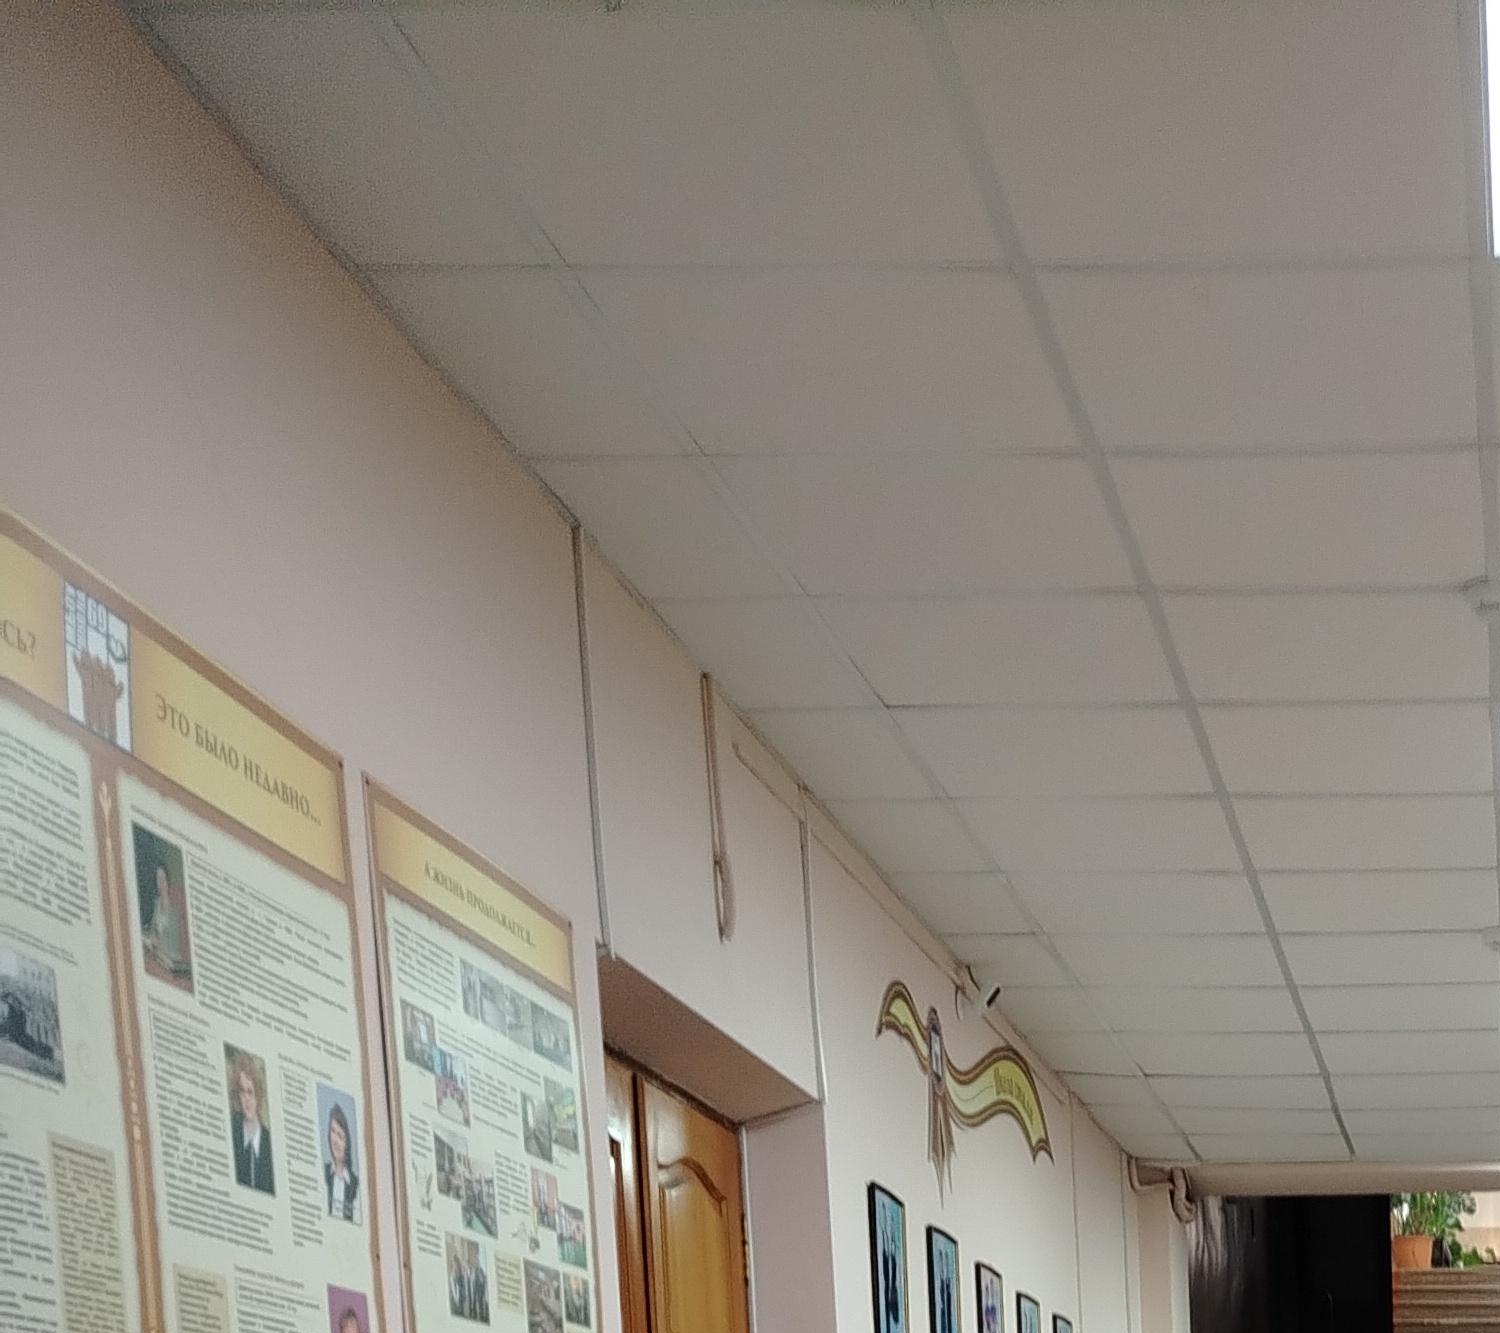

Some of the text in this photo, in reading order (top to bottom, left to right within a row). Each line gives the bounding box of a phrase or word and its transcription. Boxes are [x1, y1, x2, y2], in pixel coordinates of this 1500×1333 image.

[0, 618, 36, 661] СЬ?
[155, 692, 322, 827] ЭТО БЫЛО НЕДАВНО...
